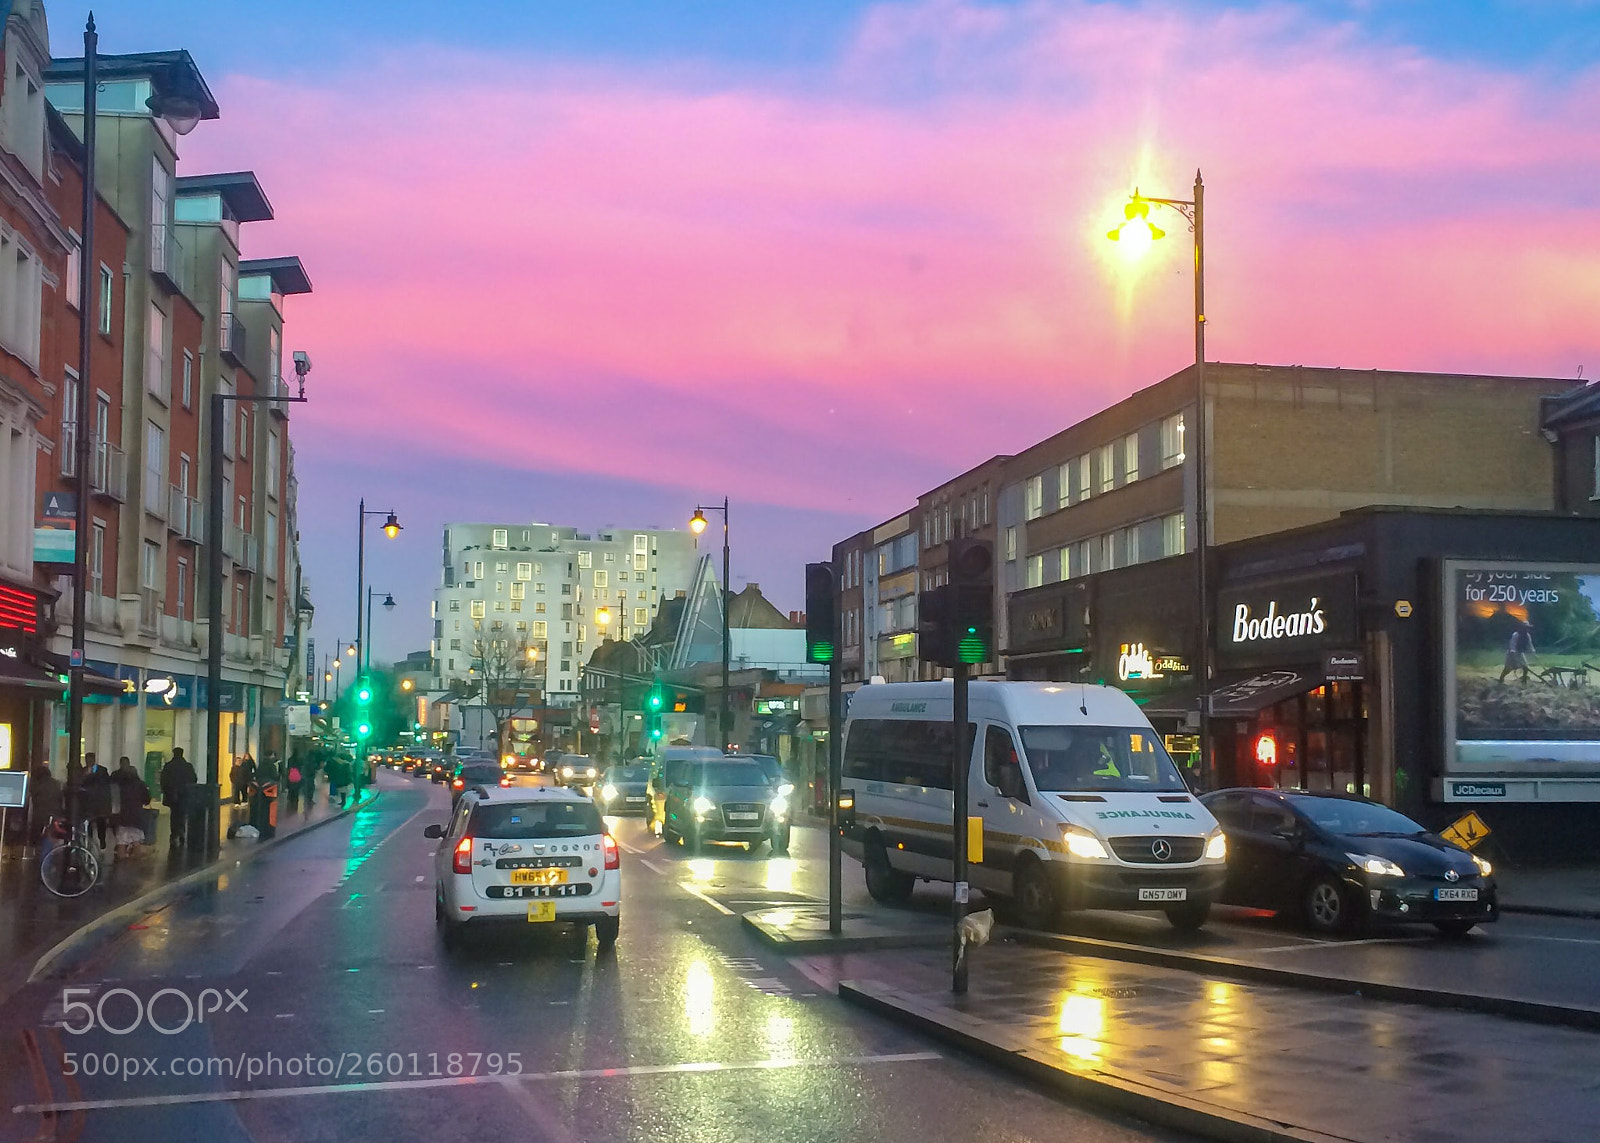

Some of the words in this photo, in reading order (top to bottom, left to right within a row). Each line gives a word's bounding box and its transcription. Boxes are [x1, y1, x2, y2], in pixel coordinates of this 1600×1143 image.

[1465, 584, 1486, 601] for
[1489, 585, 1516, 602] 250
[1519, 589, 1559, 606] years
[1233, 597, 1325, 642] Bodean's
[891, 702, 927, 713] AMBULANCE
[1456, 785, 1503, 795] JCDecaux
[503, 887, 523, 897] 81
[531, 886, 550, 897] 11
[558, 885, 577, 895] 11
[1142, 890, 1165, 899] GN57
[1440, 888, 1459, 899] EK64
